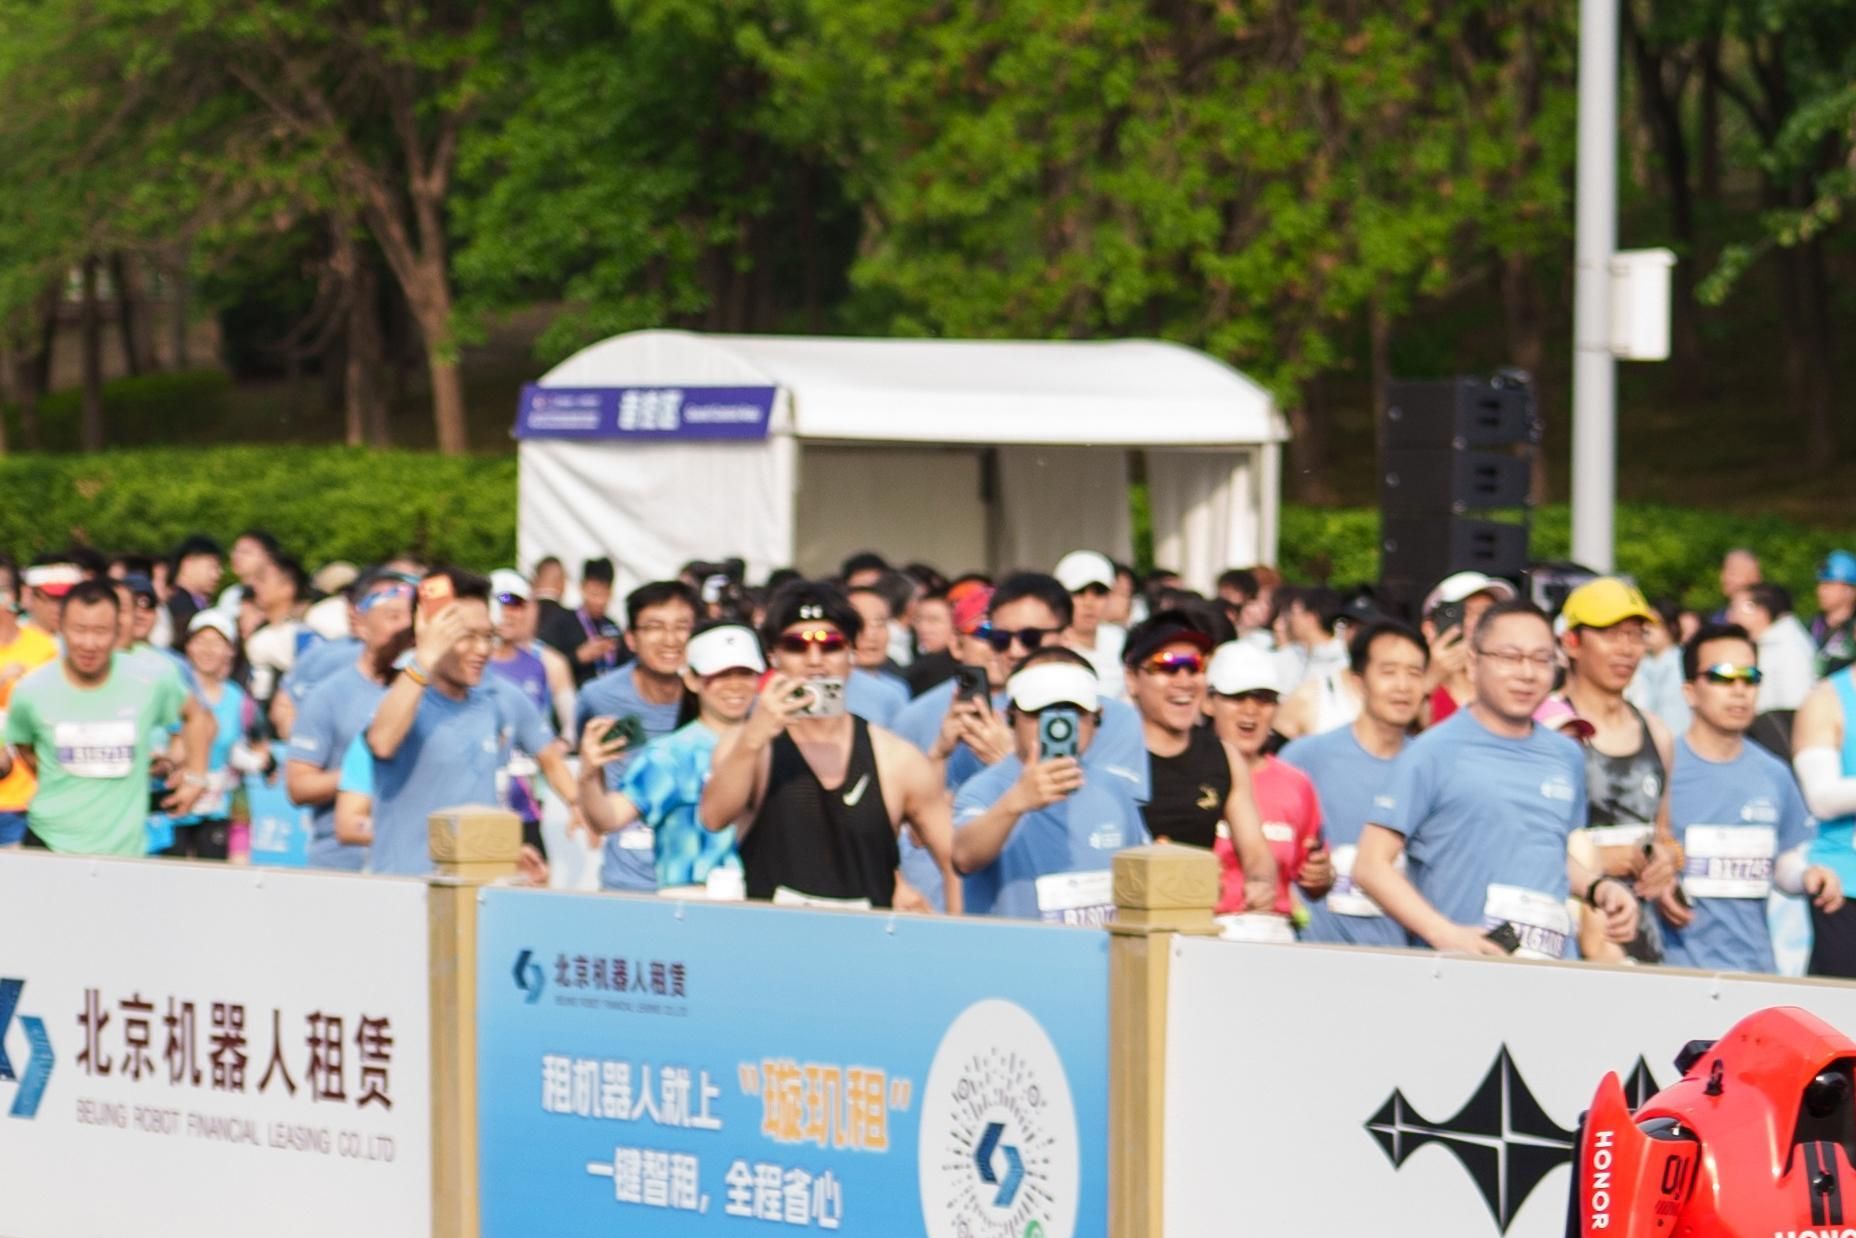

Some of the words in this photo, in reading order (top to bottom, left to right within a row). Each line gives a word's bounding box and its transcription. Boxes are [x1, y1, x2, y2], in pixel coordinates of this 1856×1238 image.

[554, 953, 688, 998] 北京机器人租赁
[75, 987, 396, 1110] 北京机器人租赁
[134, 1105, 181, 1135] ROBOT
[187, 1113, 262, 1147] FINANCIAL
[268, 1123, 330, 1155] LEASING
[1591, 1130, 1615, 1231] HONOR
